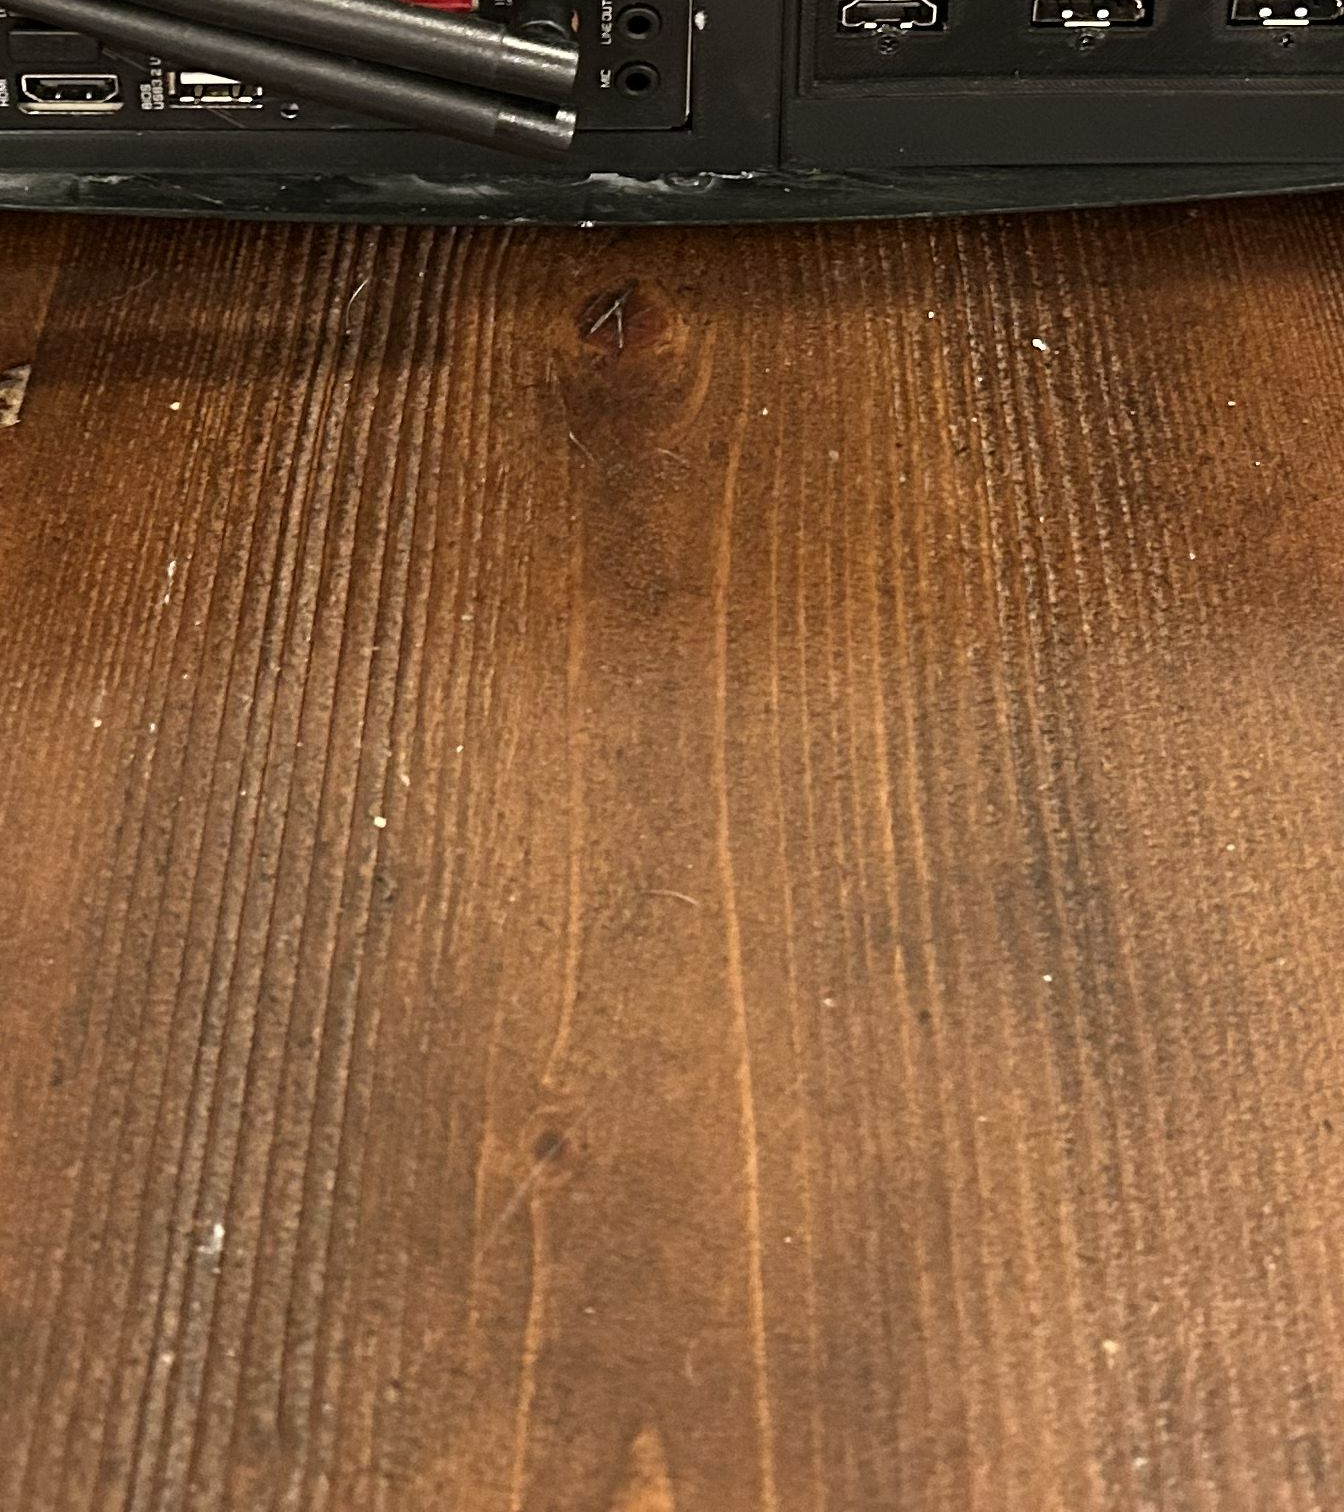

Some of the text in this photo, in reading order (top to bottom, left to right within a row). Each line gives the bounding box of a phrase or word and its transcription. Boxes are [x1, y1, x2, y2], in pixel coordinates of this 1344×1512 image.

[600, 0, 613, 45] LINE OUT
[599, 68, 612, 89] MIC
